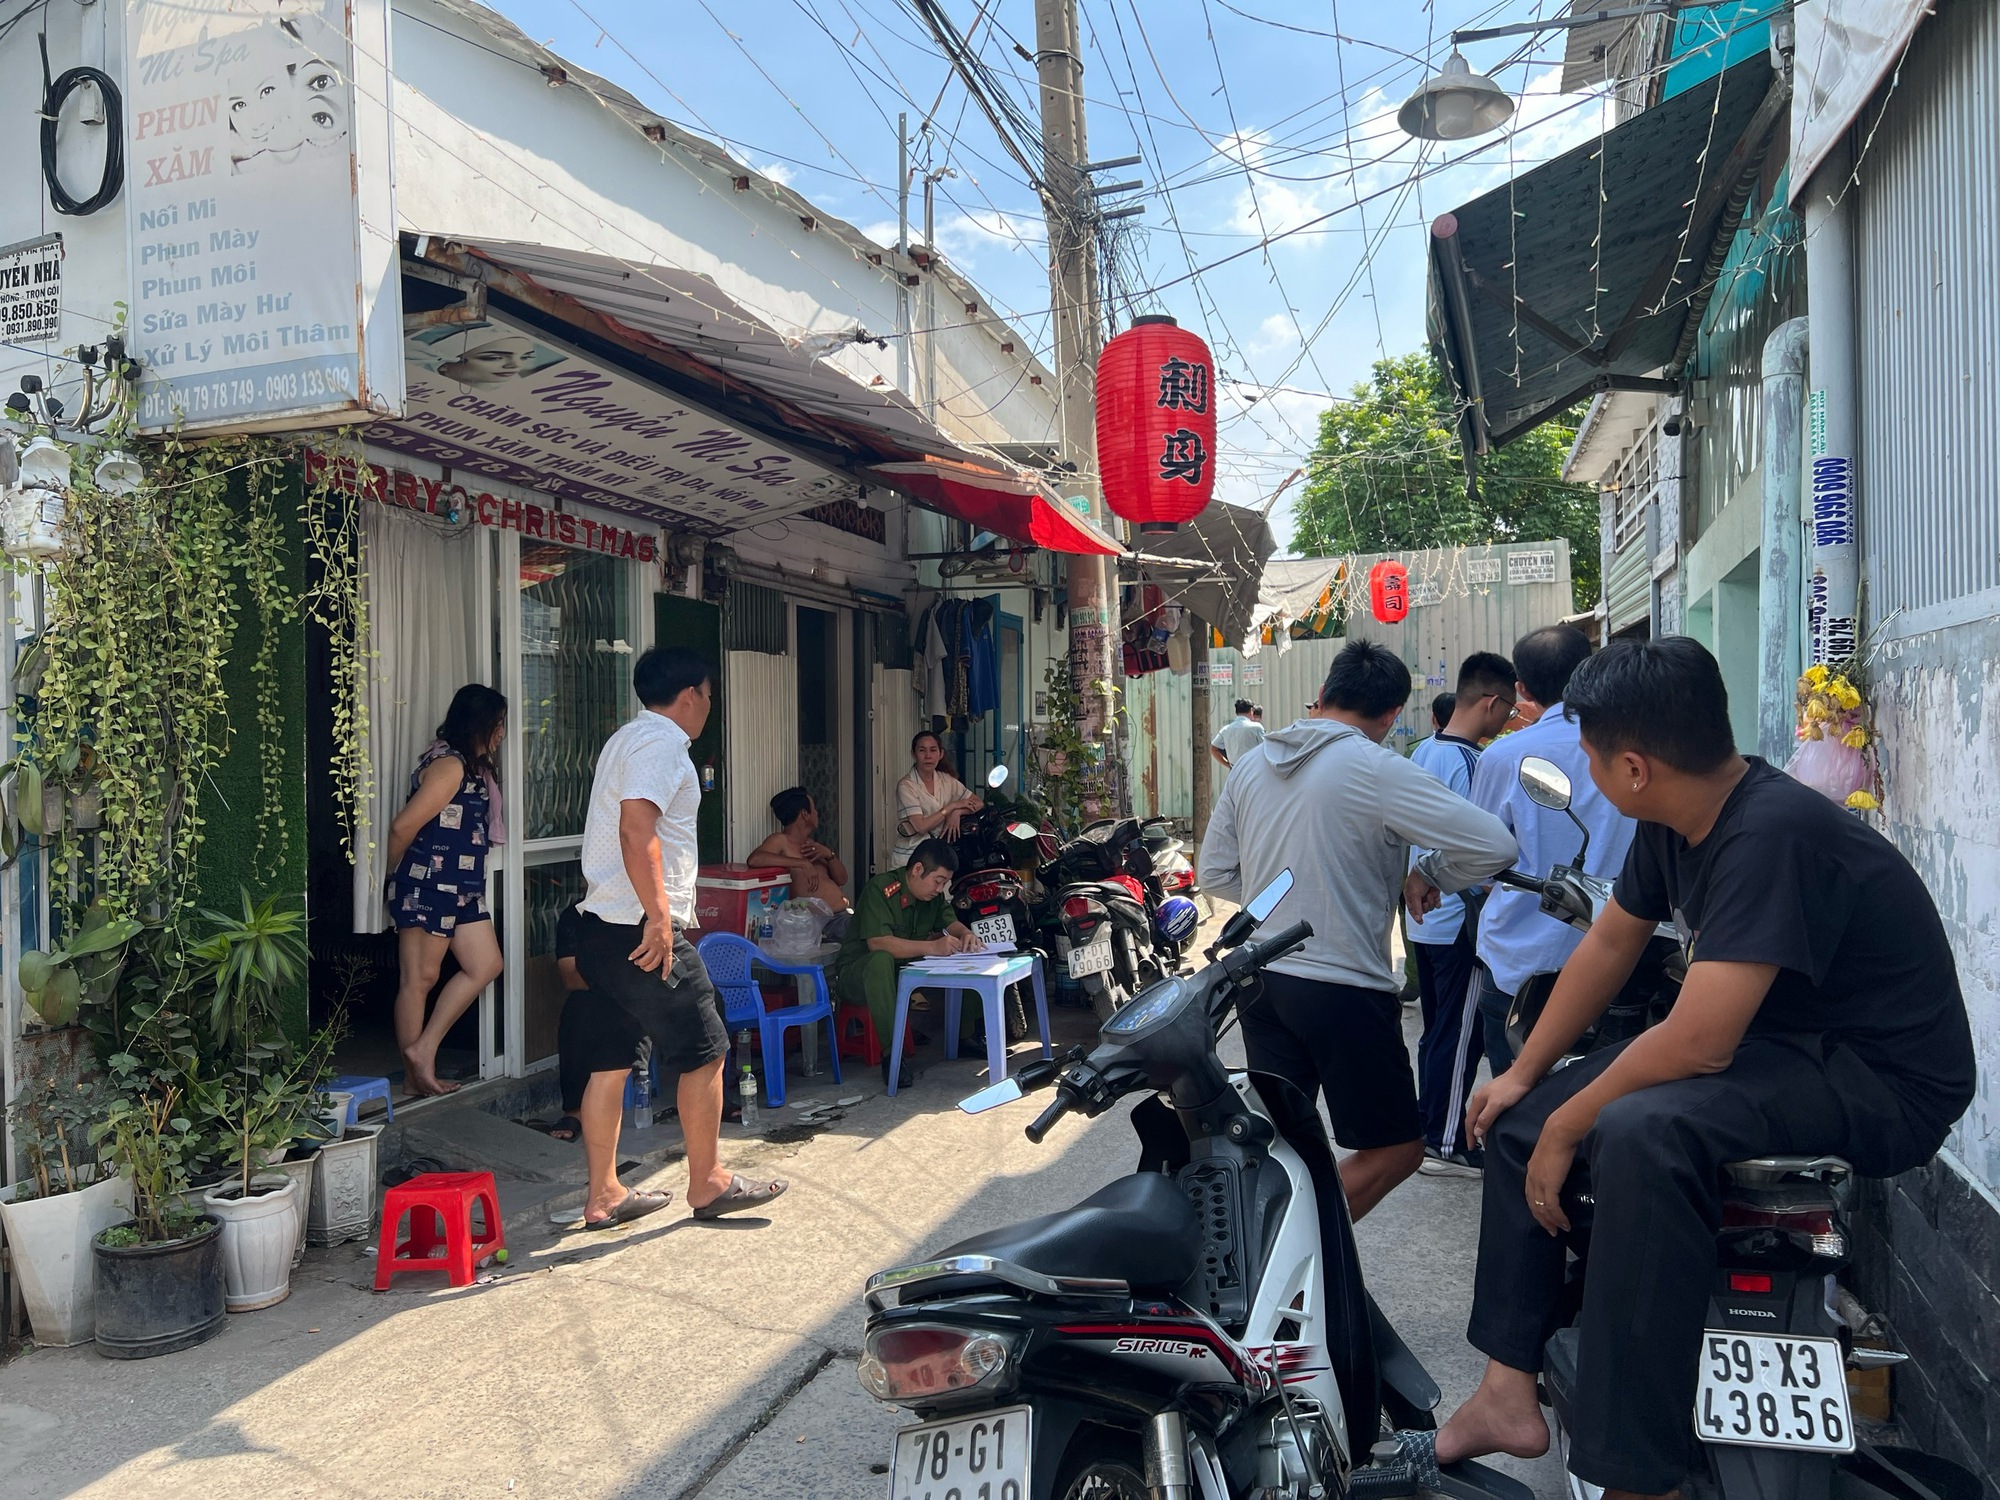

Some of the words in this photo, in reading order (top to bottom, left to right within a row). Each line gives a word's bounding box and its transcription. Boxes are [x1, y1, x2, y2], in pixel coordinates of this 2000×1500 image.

[139, 49, 183, 86] Mi
[194, 38, 250, 76] Spa
[136, 95, 221, 141] PHUN
[144, 145, 214, 188] XĂM
[140, 203, 178, 231] Nối
[187, 198, 217, 221] Mi
[34, 253, 60, 284] NHÀ
[141, 240, 200, 265] Phun
[210, 228, 259, 252] Mày
[142, 276, 201, 299] Phun
[211, 261, 256, 287] Môi
[143, 309, 188, 334] Sửa
[197, 301, 247, 325] Mày
[257, 292, 293, 315] Hư
[145, 343, 177, 368] Xử
[185, 339, 213, 363] Lý
[223, 328, 269, 355] Môi
[276, 323, 350, 347] Thâm
[193, 385, 209, 411] 79
[212, 382, 228, 408] 78
[231, 378, 254, 406] 749
[265, 372, 297, 402] 0903
[301, 369, 325, 397] 133
[405, 411, 488, 442] PHUN
[476, 435, 542, 459] XĂM
[593, 472, 642, 487] MỸ
[531, 370, 690, 439] Nguyễn
[725, 455, 797, 487] Spa
[447, 395, 533, 428] CHĂM
[521, 422, 578, 444] SÓC
[571, 438, 613, 455] VÀ
[738, 499, 770, 511] MI
[415, 442, 464, 460] 79
[464, 457, 510, 473] 78
[580, 490, 645, 512] 0903
[641, 508, 688, 524] 133
[476, 493, 655, 564] CHRISTMAS
[977, 917, 1007, 935] 59-S3
[1071, 955, 1110, 976] 490.66
[1729, 1308, 1777, 1319] HONDA
[1110, 1338, 1193, 1355] SIRIUS
[1188, 1348, 1208, 1359] RC
[1708, 1337, 1821, 1389] 59-X3
[1703, 1387, 1843, 1443] 438.56
[913, 1418, 1006, 1485] 78-G1
